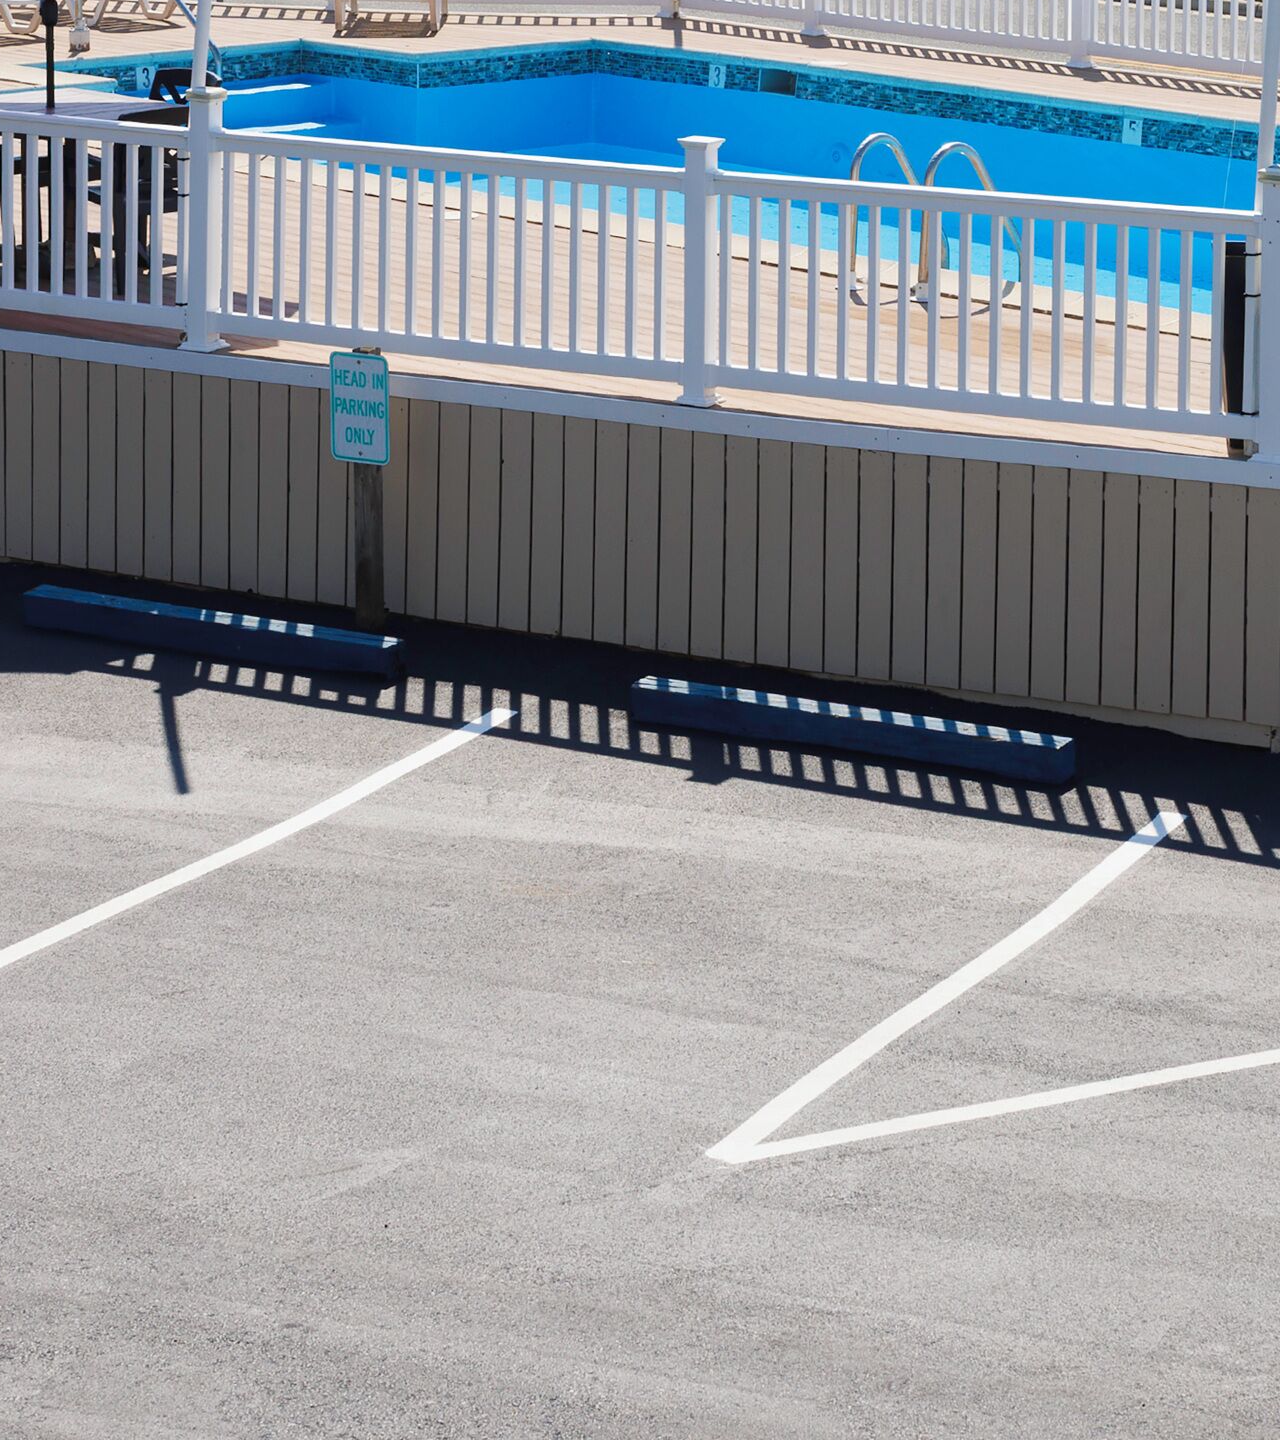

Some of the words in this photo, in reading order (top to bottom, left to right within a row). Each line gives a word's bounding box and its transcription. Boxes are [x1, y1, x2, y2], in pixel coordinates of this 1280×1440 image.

[142, 67, 151, 88] 3
[714, 66, 721, 86] 3
[334, 369, 367, 388] HEAD
[372, 373, 384, 390] IN
[334, 397, 385, 419] PARKING
[344, 426, 375, 446] ONLY
